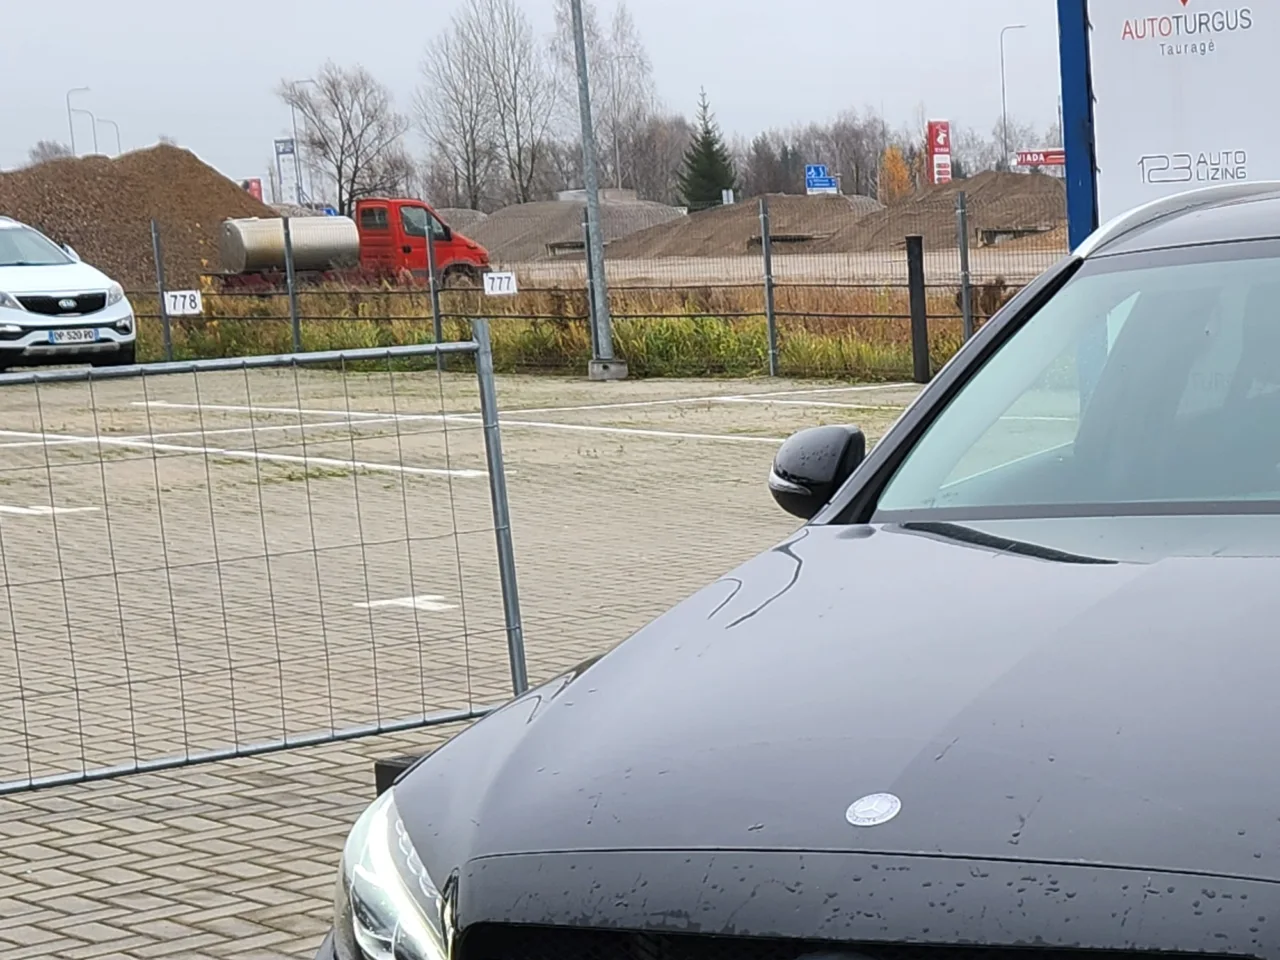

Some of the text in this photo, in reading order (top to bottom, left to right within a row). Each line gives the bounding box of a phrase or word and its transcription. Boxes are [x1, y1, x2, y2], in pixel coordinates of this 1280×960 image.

[1121, 8, 1253, 41] AUTOTURGUS
[1159, 39, 1216, 56] Tauragė
[1137, 150, 1247, 184] 123 AUTO
[1196, 166, 1247, 182] LIZING
[488, 276, 512, 291] 777
[169, 293, 198, 311] 778
